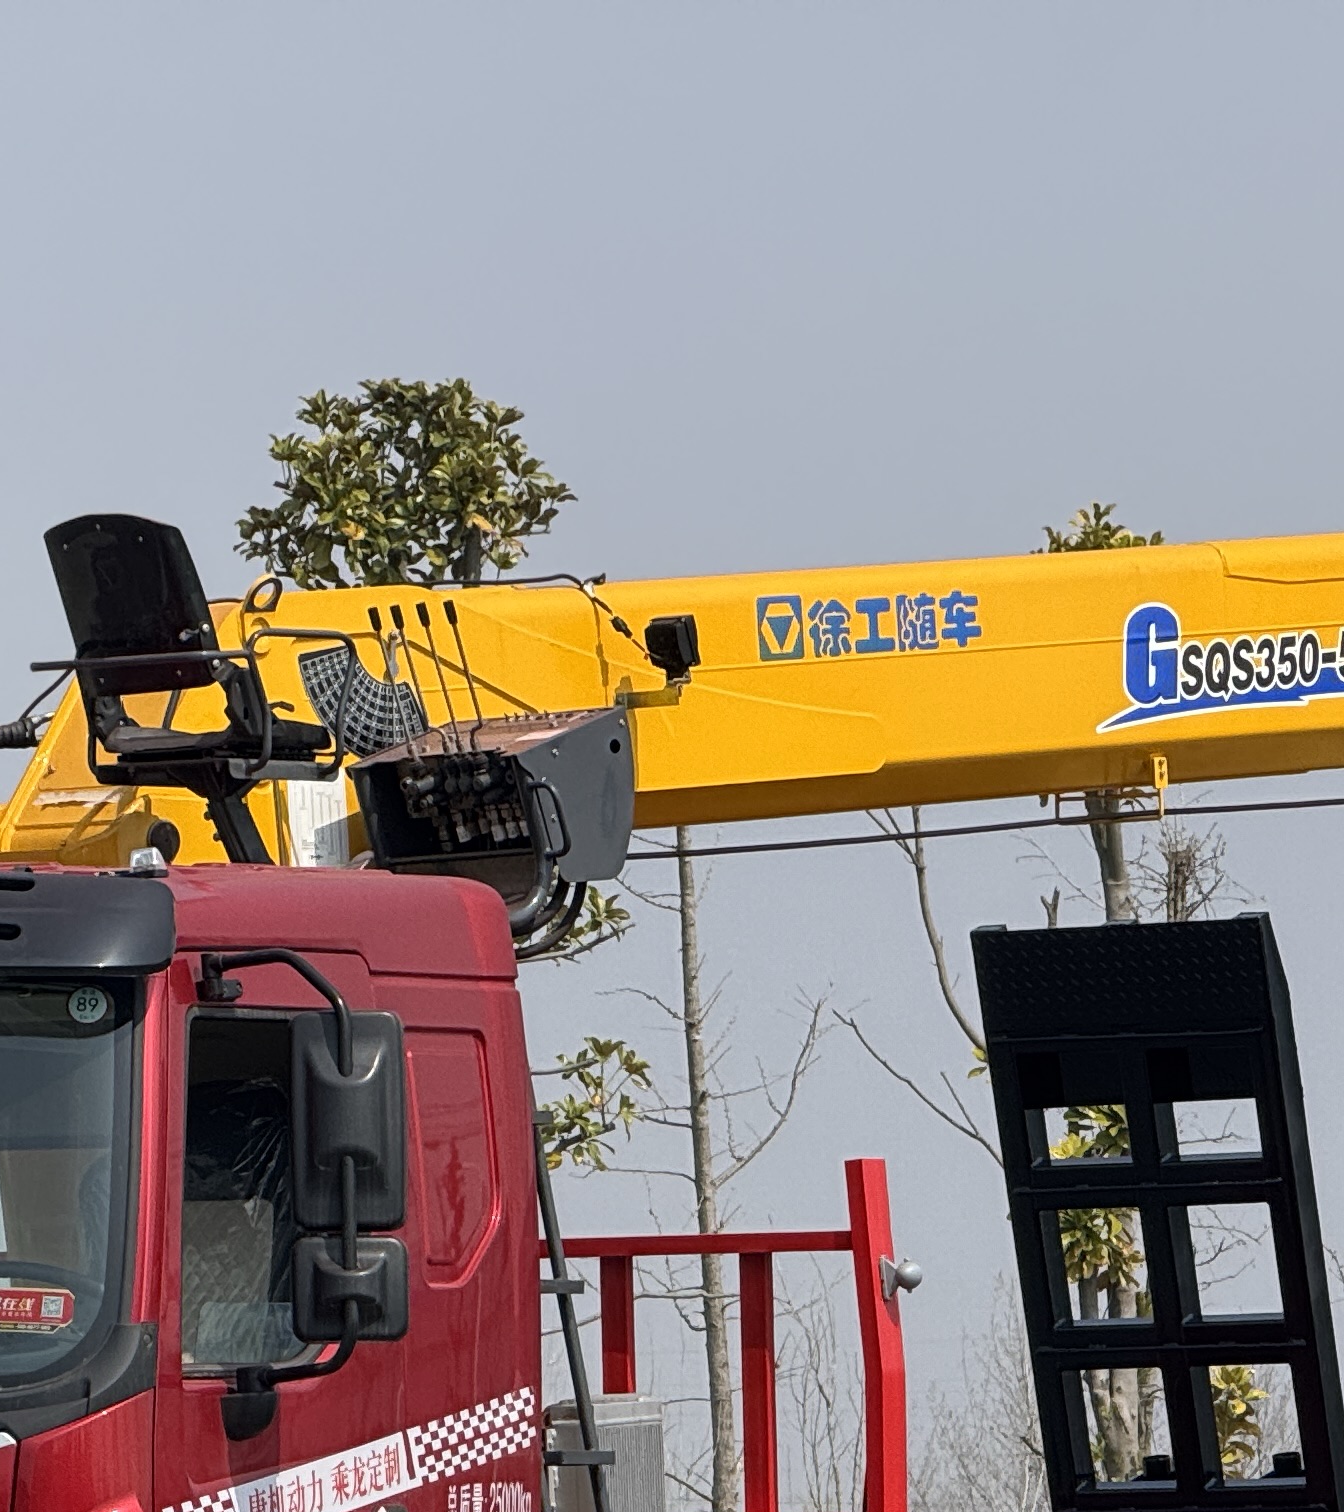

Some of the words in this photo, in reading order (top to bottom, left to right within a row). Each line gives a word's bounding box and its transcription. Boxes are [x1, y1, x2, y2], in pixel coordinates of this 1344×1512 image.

[807, 590, 982, 658] 徐工随车
[76, 997, 99, 1012] 89
[331, 1443, 402, 1506] 乘龙定制
